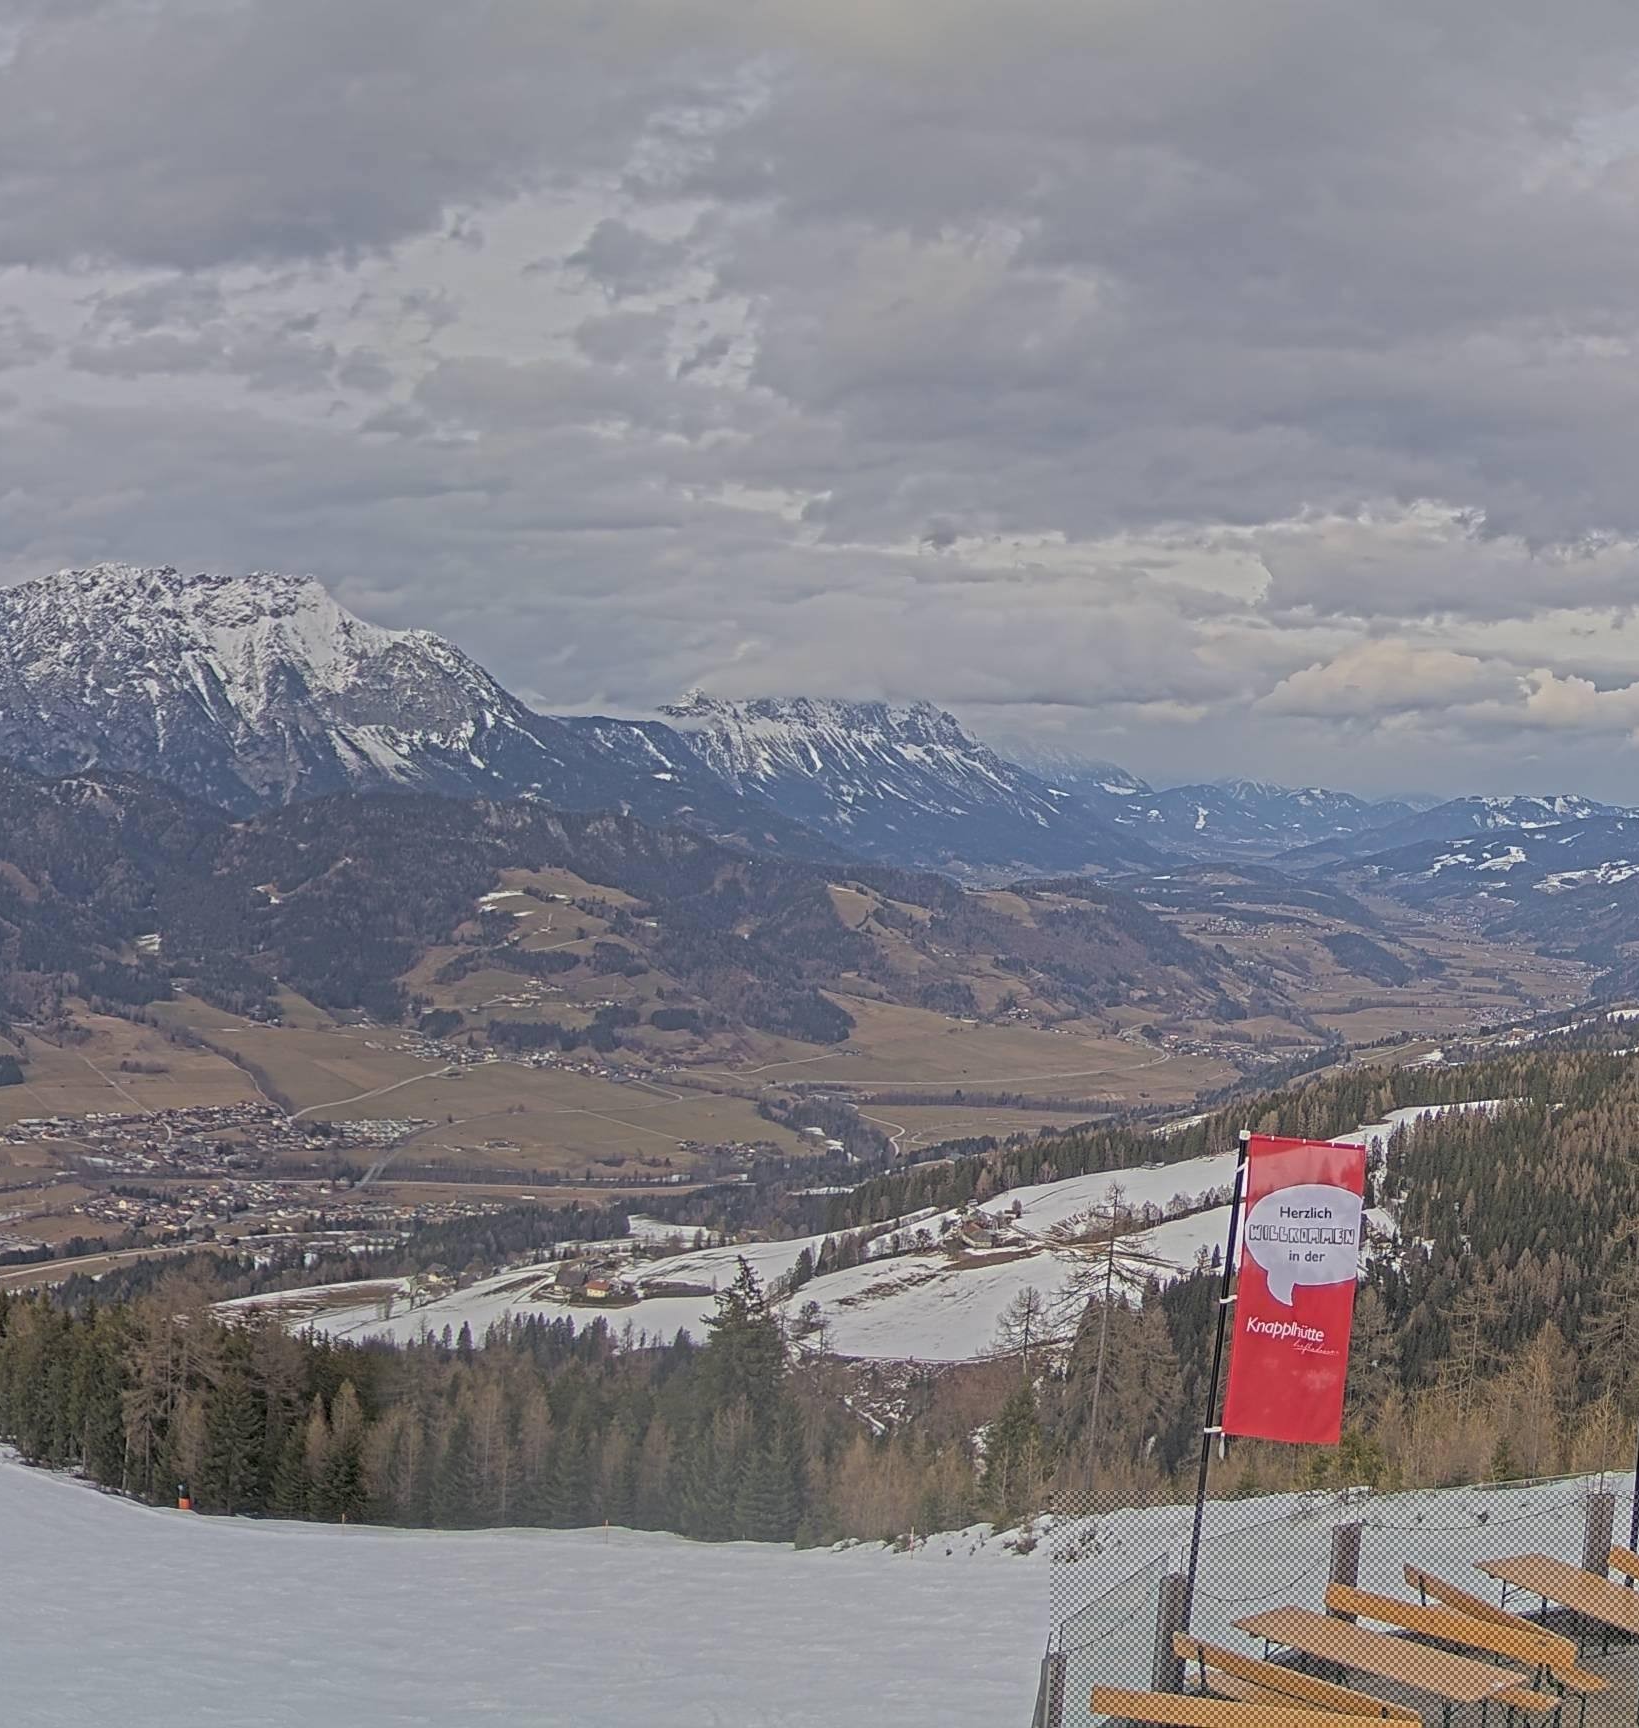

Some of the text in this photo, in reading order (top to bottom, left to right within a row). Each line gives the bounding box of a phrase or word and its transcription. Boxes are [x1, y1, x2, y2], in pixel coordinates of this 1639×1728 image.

[1279, 1206, 1332, 1219] Herzlich
[1248, 1224, 1355, 1245] WILLKOMMEN
[1289, 1250, 1325, 1262] in der
[1246, 1316, 1325, 1342] Knapplhütte
